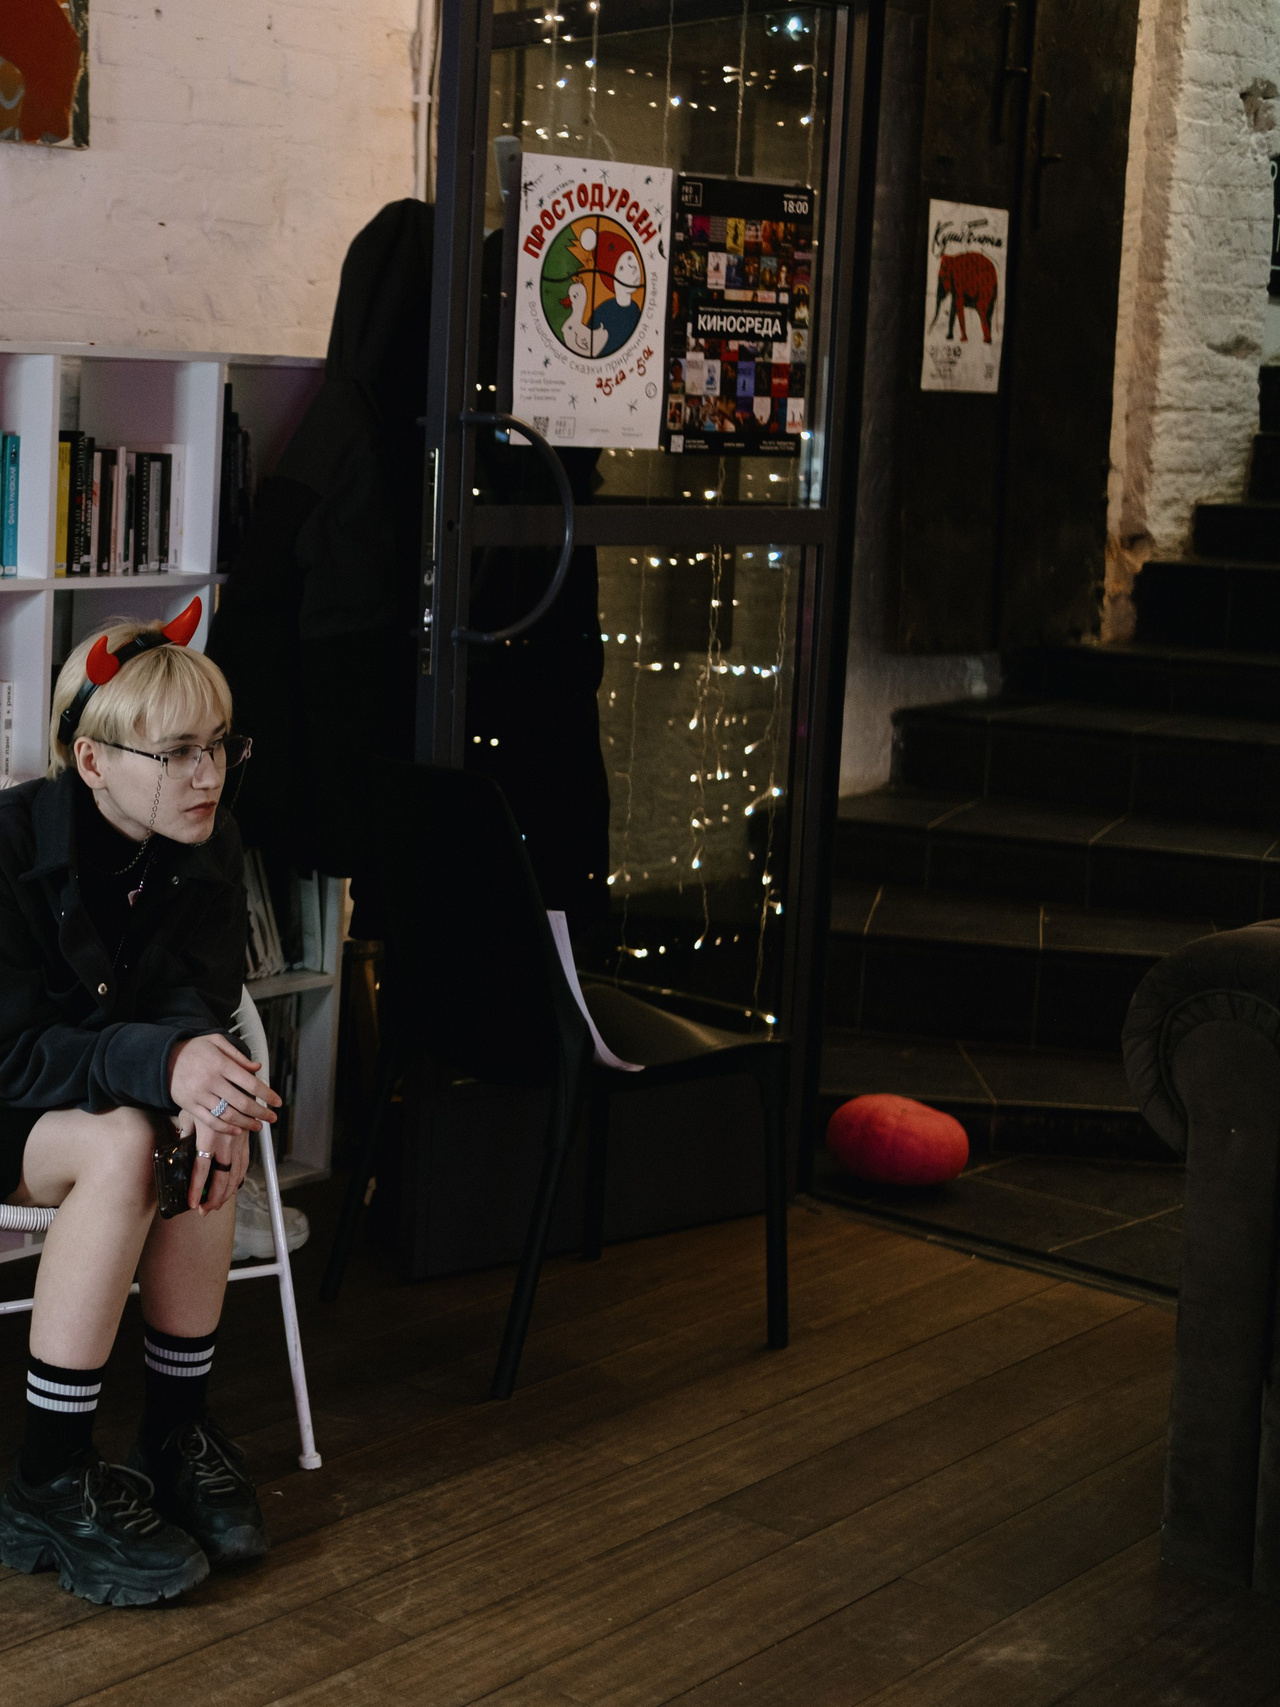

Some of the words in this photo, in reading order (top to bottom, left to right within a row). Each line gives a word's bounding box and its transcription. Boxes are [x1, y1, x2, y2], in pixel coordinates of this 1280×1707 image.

[783, 200, 809, 214] 18:00
[523, 183, 657, 259] ПРОСТОДУРСЕН
[698, 314, 782, 338] КИНОСРЕДА
[569, 361, 603, 374] сказки
[8, 467, 16, 502] РАНЕВСКАЯ
